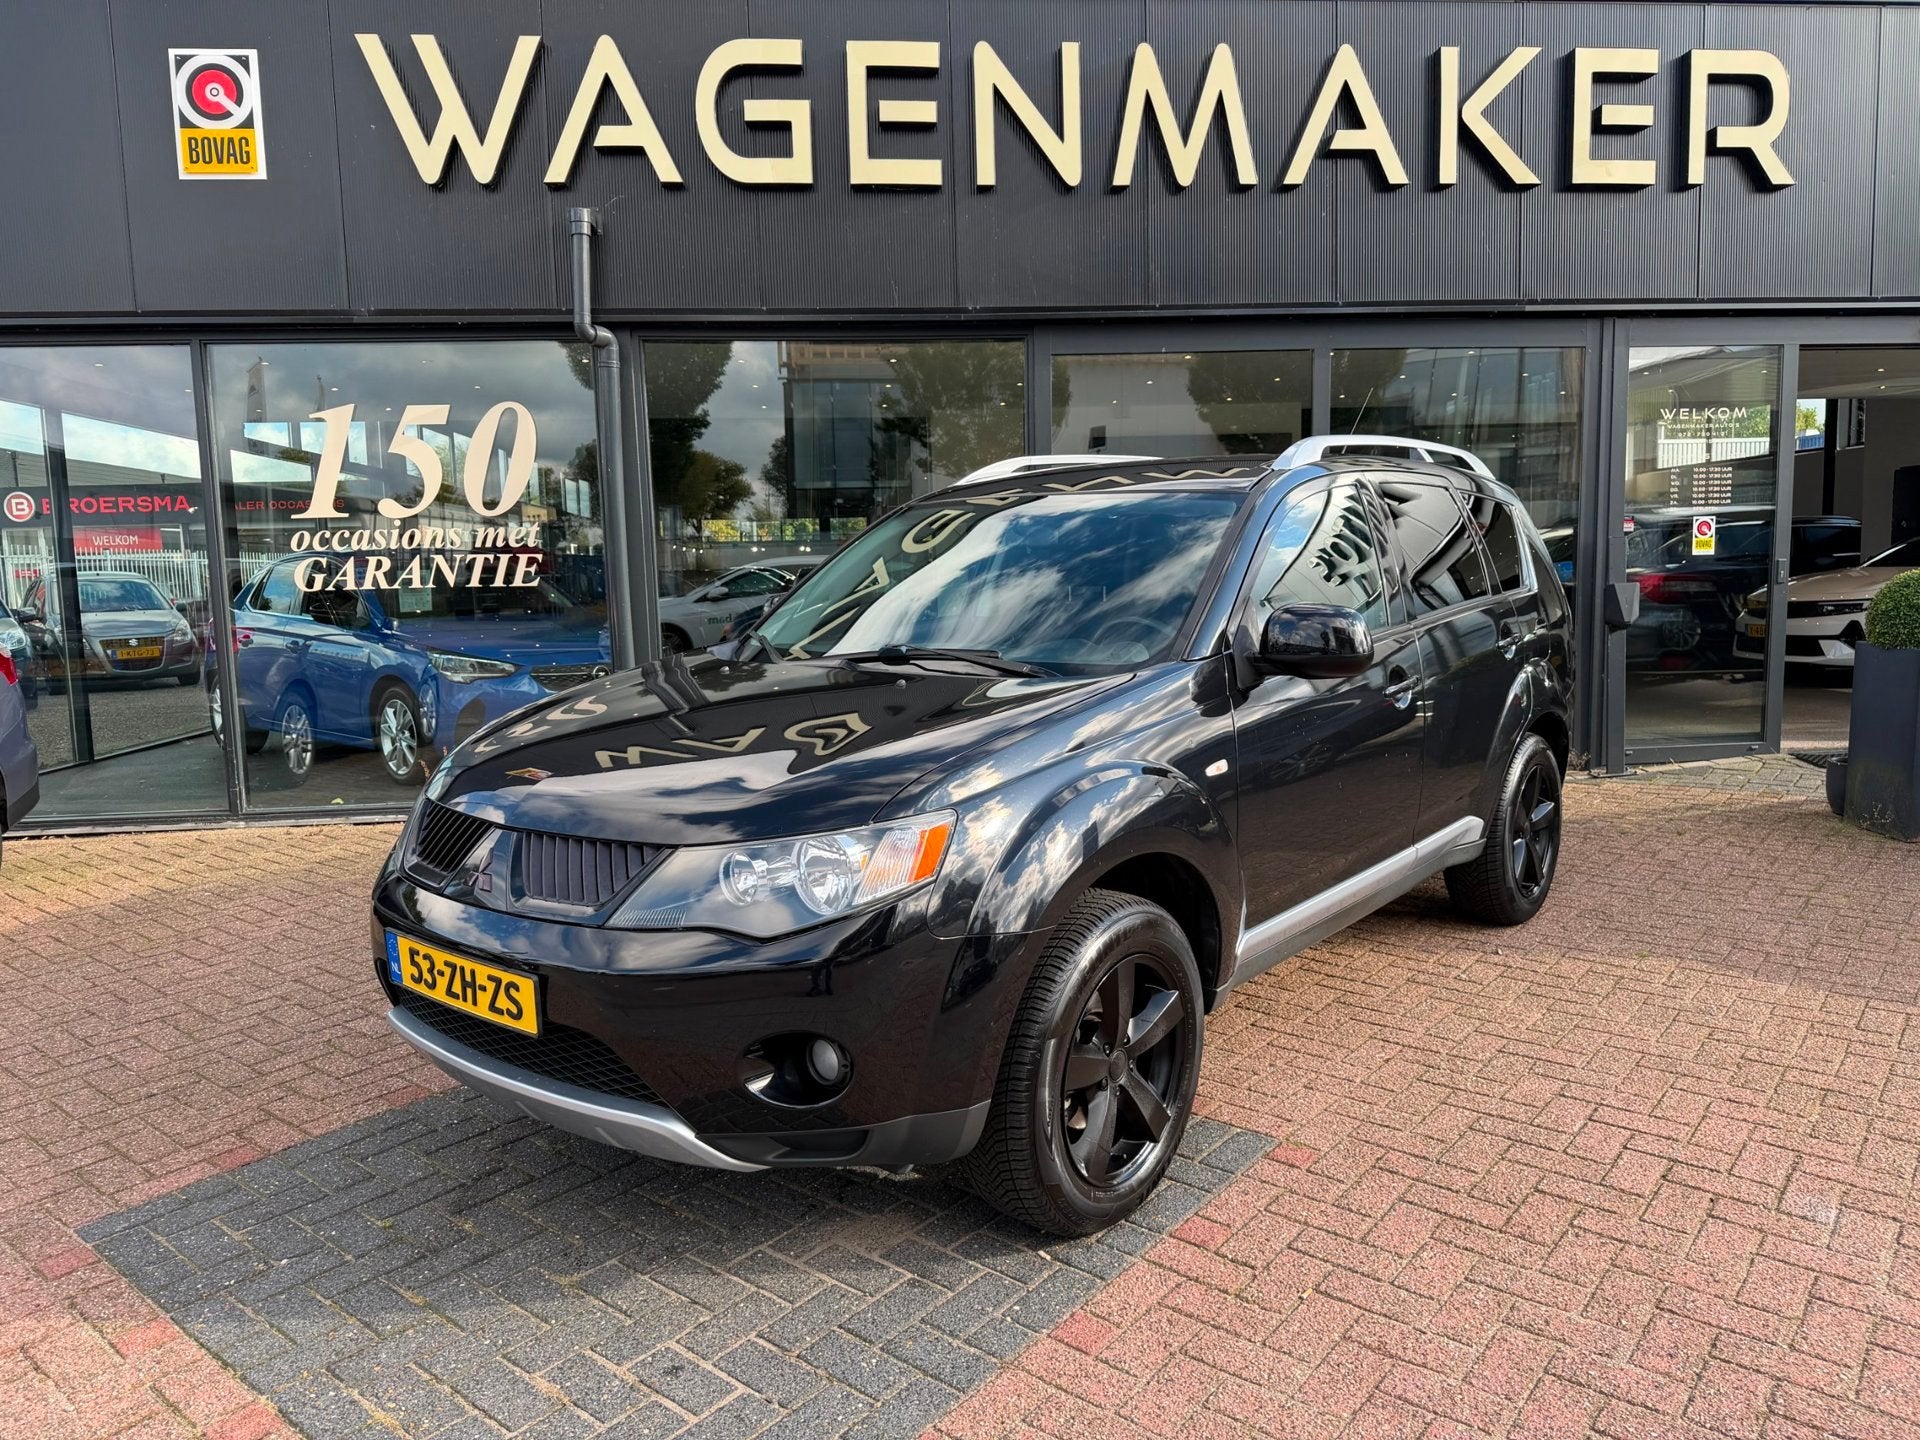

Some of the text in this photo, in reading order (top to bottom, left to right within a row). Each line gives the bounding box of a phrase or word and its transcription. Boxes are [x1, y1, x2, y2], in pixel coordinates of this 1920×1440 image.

[354, 33, 1796, 187] WAGENMAKER
[187, 136, 251, 165] BOVAG
[1659, 406, 1748, 420] WELKOM
[291, 400, 538, 520] 150
[269, 499, 345, 511] OCCASS
[92, 534, 139, 546] WELKOM
[290, 519, 540, 552] occasions met
[1695, 539, 1712, 549] BOVAG
[293, 553, 544, 592] GARANTIE
[391, 961, 401, 975] NL
[408, 945, 524, 1021] 53-ZH-ZS
